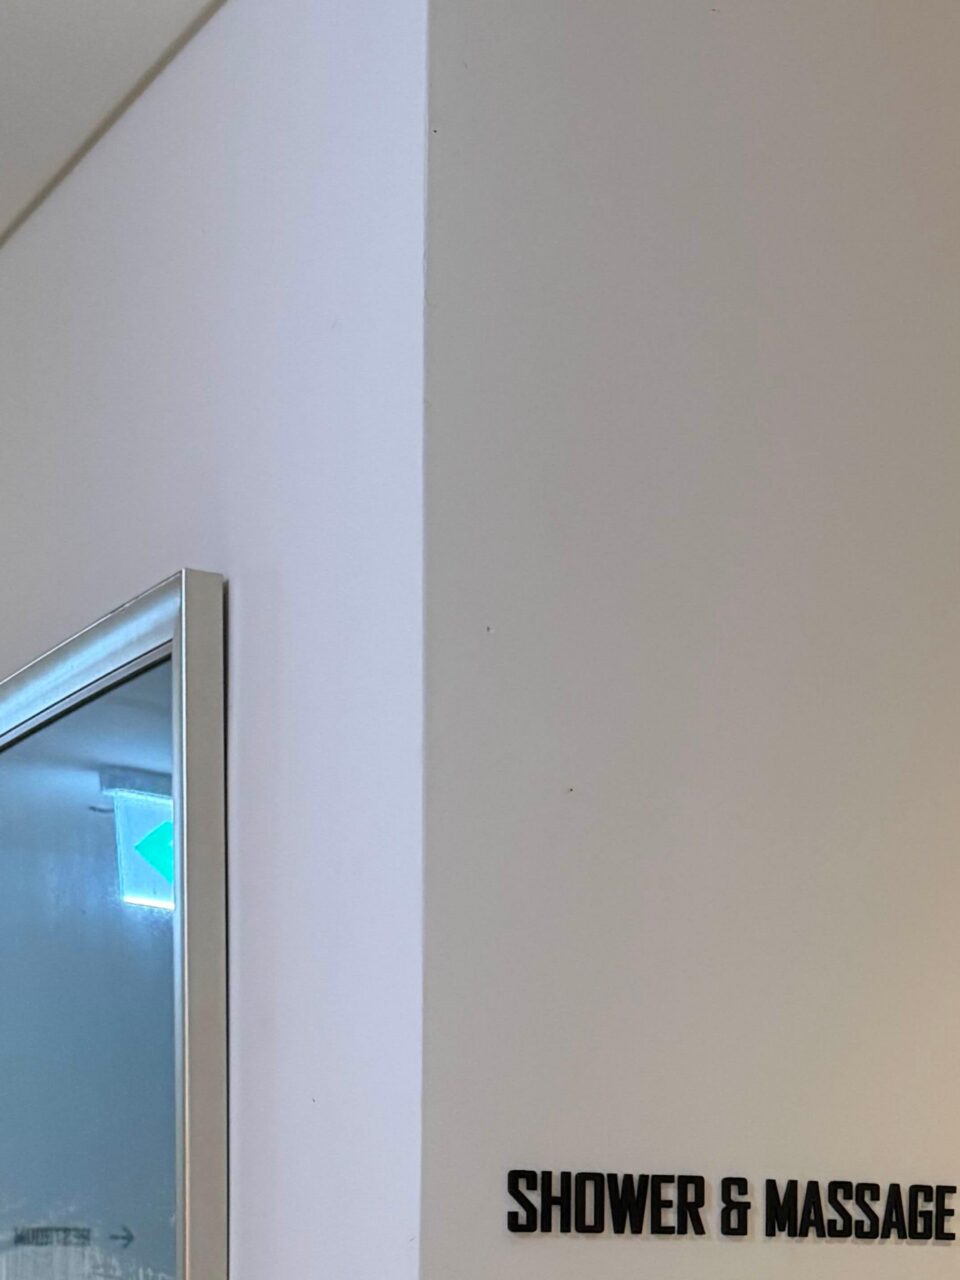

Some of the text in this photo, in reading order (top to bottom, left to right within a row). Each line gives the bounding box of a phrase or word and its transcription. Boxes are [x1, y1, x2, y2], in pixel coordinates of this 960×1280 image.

[506, 1169, 958, 1242] SHOWER & MASSAGE
